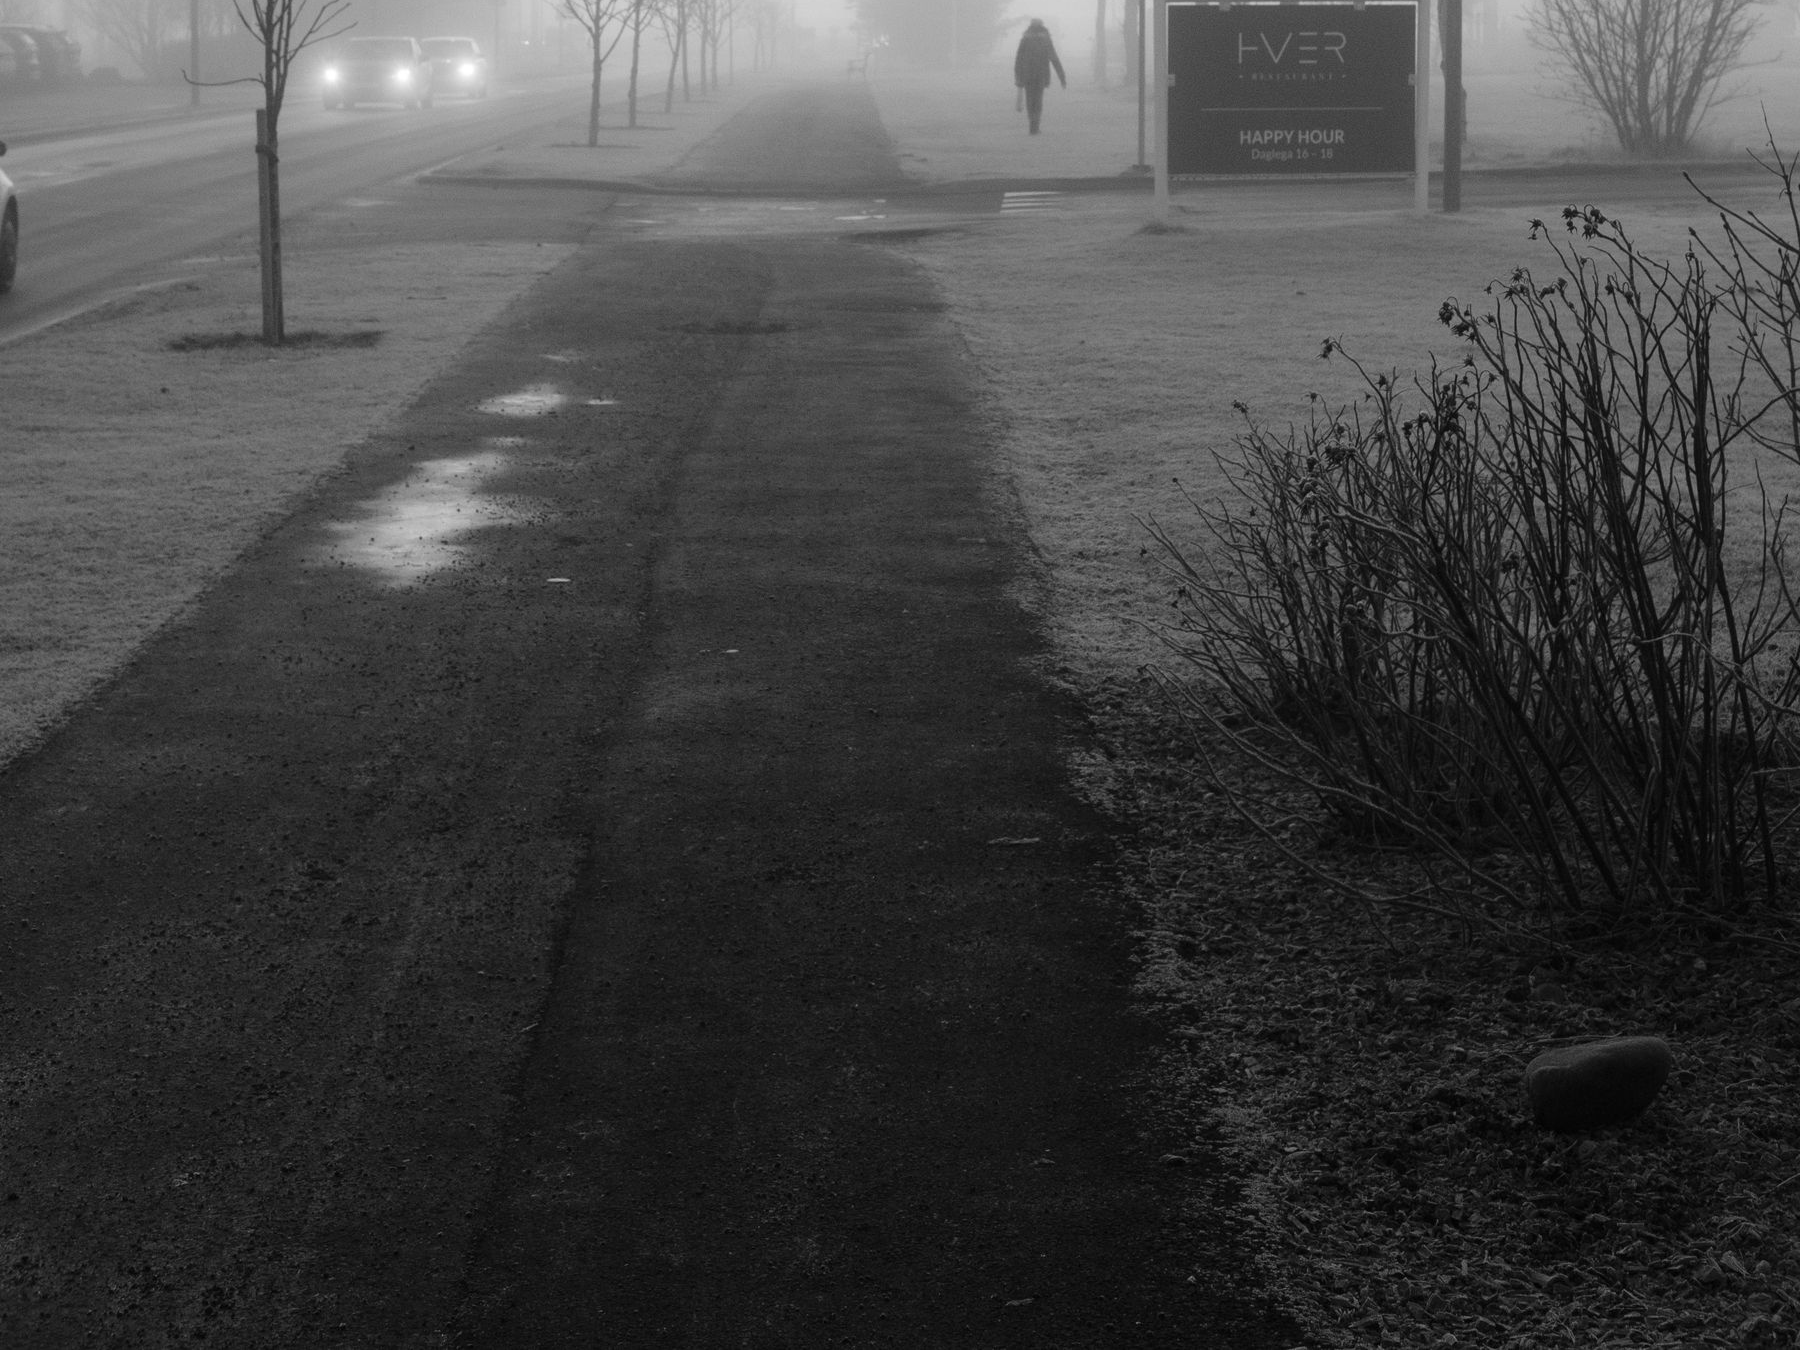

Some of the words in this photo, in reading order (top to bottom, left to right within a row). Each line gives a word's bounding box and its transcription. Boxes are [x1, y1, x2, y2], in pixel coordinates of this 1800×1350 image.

[1238, 32, 1347, 64] HVER
[1239, 129, 1294, 145] HAPPY
[1298, 129, 1345, 144] HOUR
[1296, 148, 1309, 159] 16
[1321, 148, 1333, 159] 18
